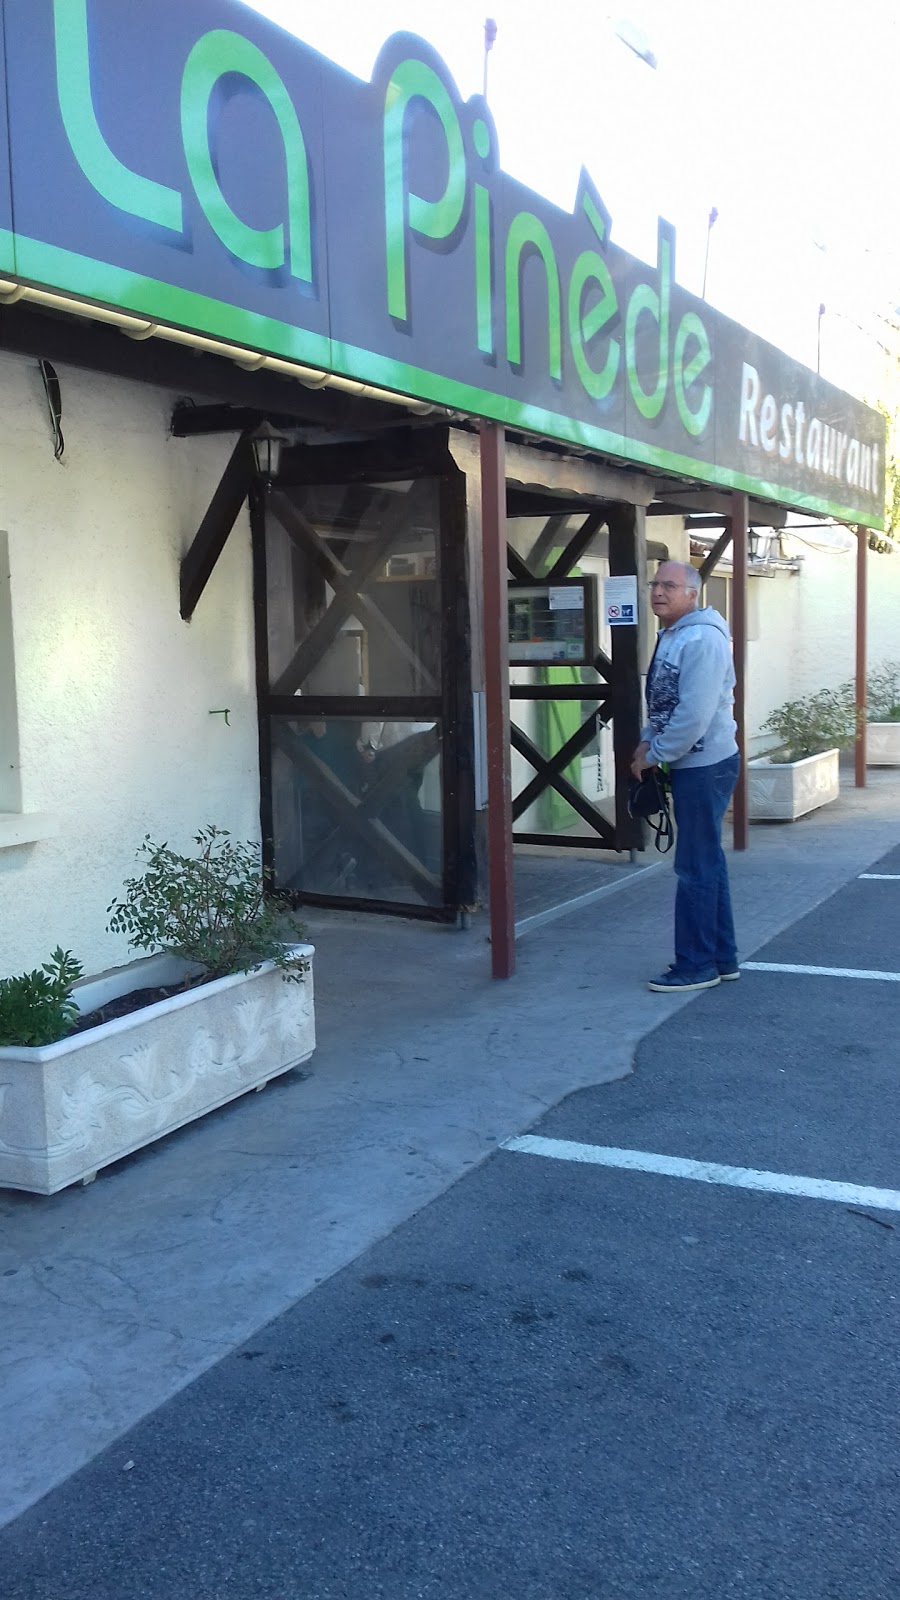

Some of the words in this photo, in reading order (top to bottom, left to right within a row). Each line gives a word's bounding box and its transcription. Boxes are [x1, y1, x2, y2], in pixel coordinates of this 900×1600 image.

[53, 0, 312, 283] La
[384, 58, 714, 436] Pinède
[738, 361, 879, 497] Restaurant
